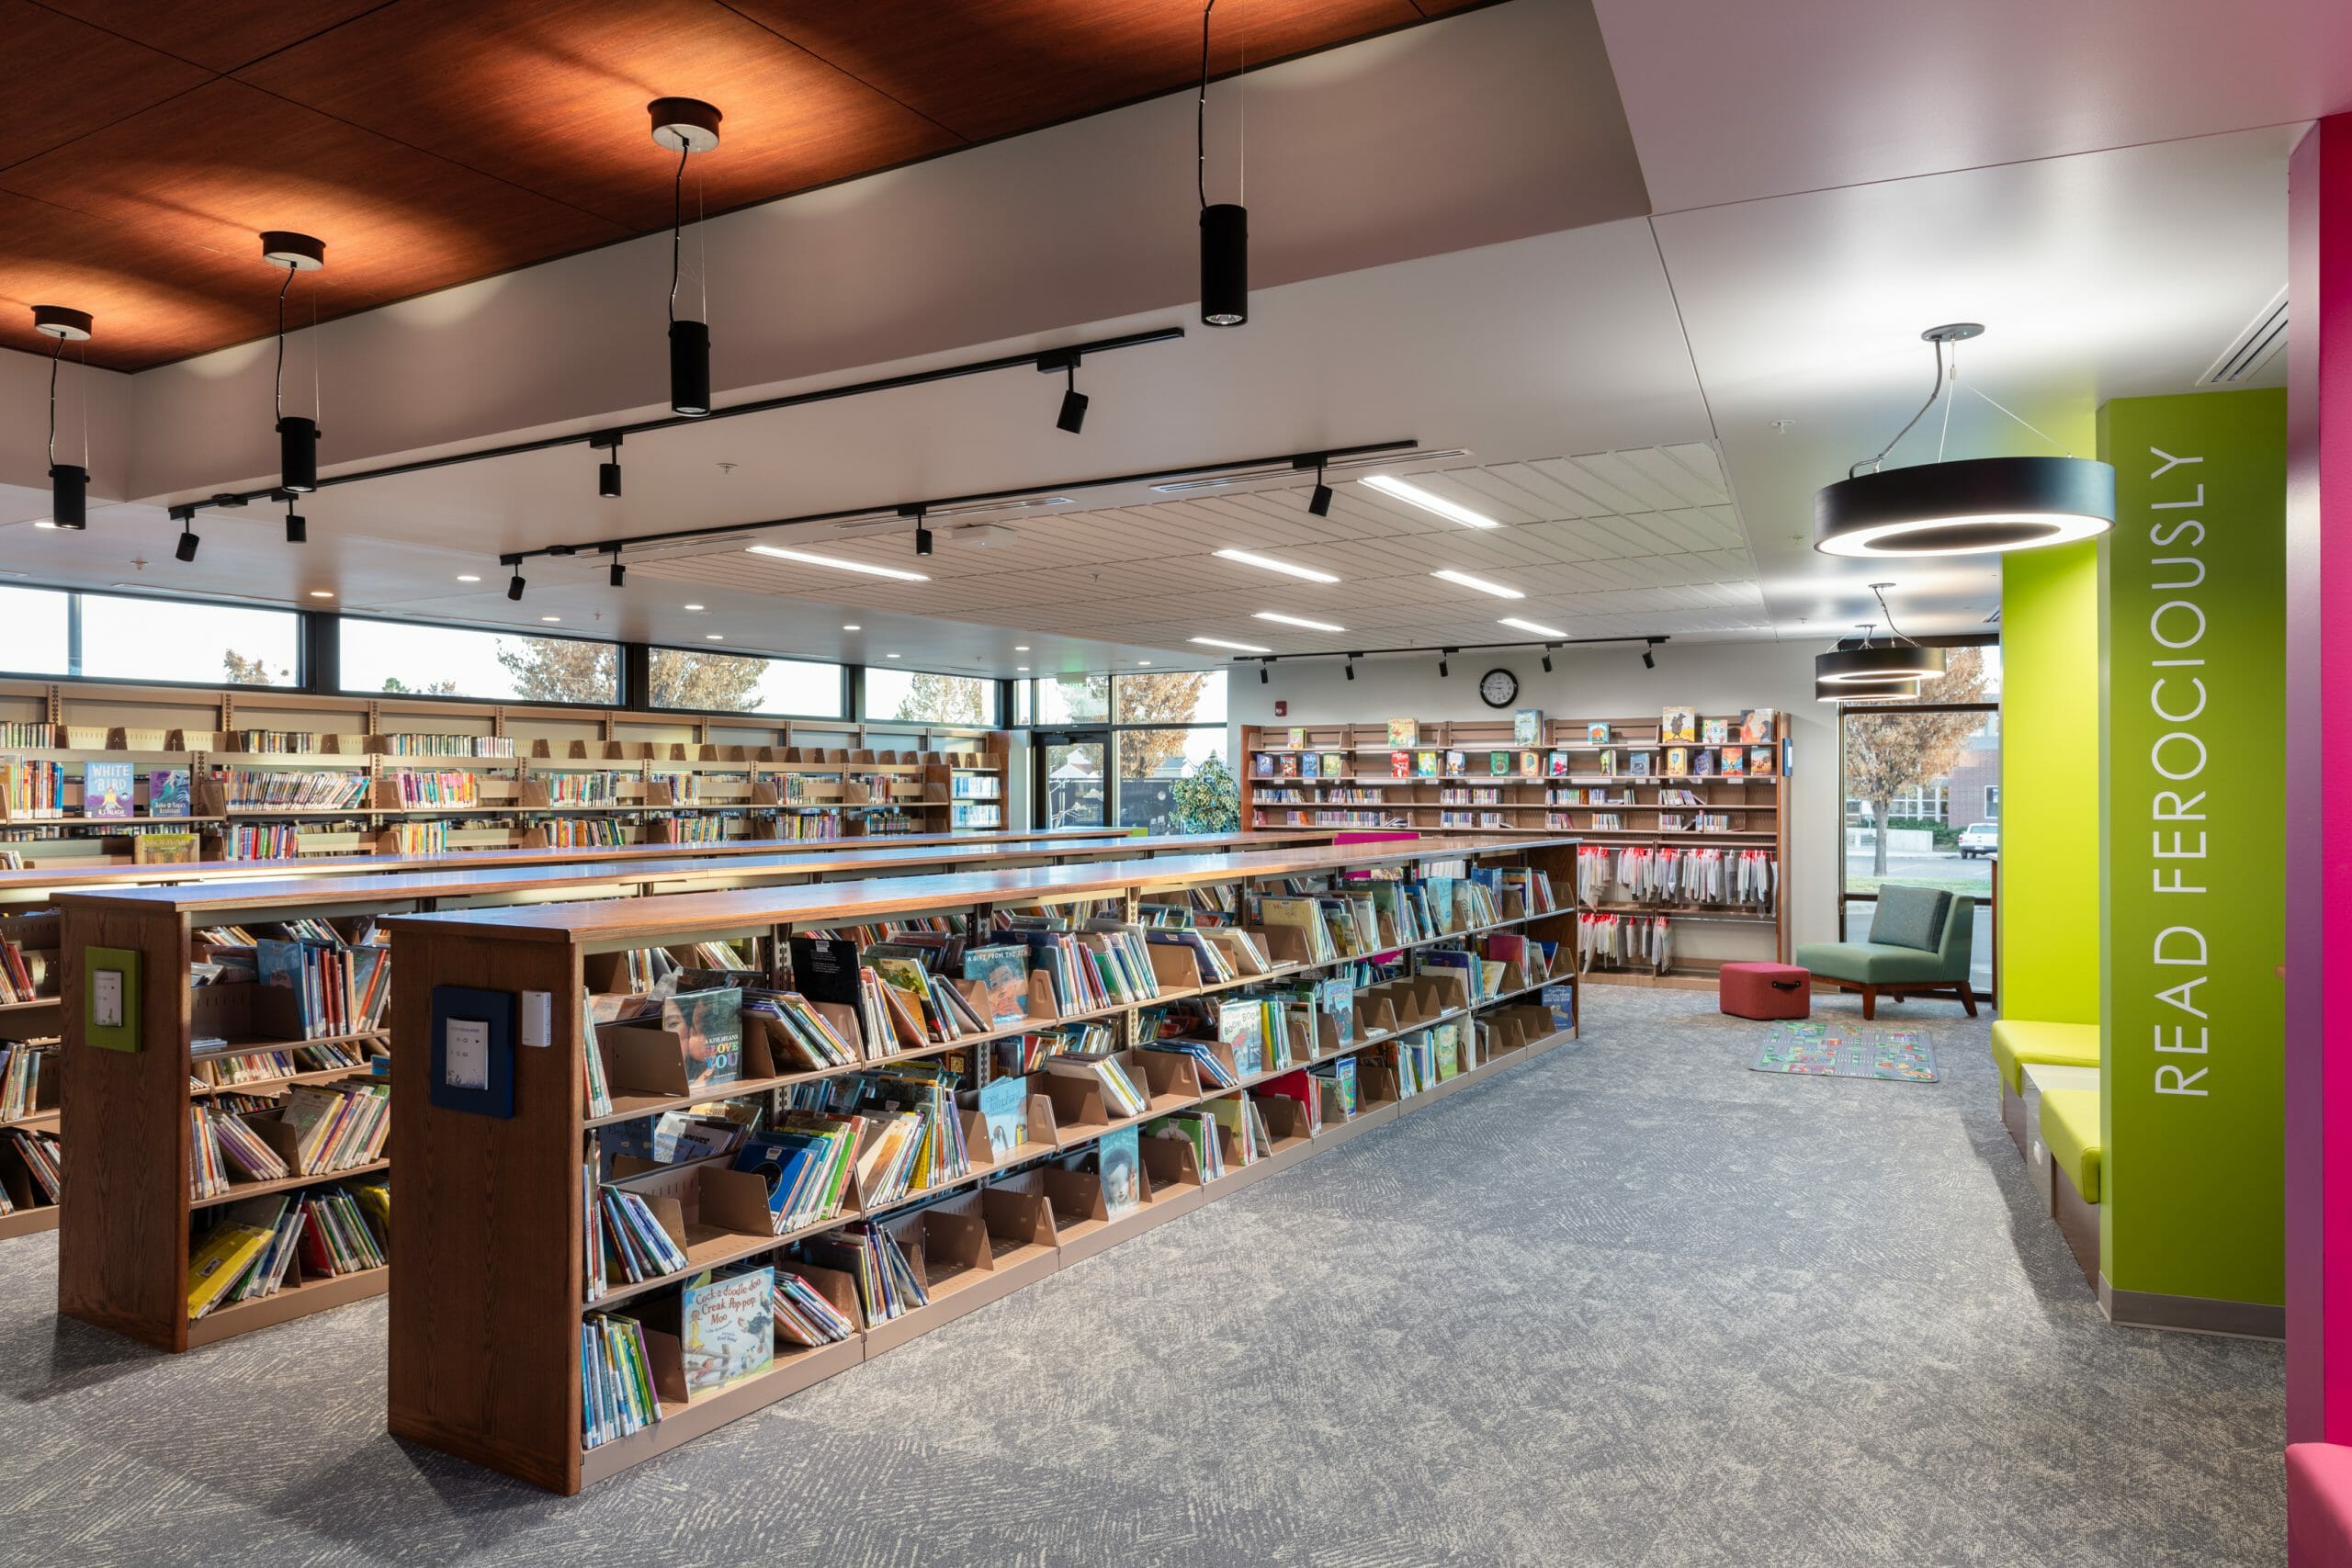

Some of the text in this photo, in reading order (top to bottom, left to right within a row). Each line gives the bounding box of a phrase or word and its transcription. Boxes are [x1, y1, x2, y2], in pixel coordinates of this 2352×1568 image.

[92, 763, 130, 777] WHITE
[2149, 446, 2209, 1096] READ FEROCIOUSLY
[97, 778, 127, 792] BIRD
[973, 953, 989, 962] GIFT
[988, 952, 1004, 960] FROM
[721, 1034, 739, 1043] MEANS
[709, 1041, 739, 1055] LOVE
[705, 1052, 739, 1071] YOU
[701, 1298, 726, 1315] Creak
[711, 1314, 728, 1325] Moo
